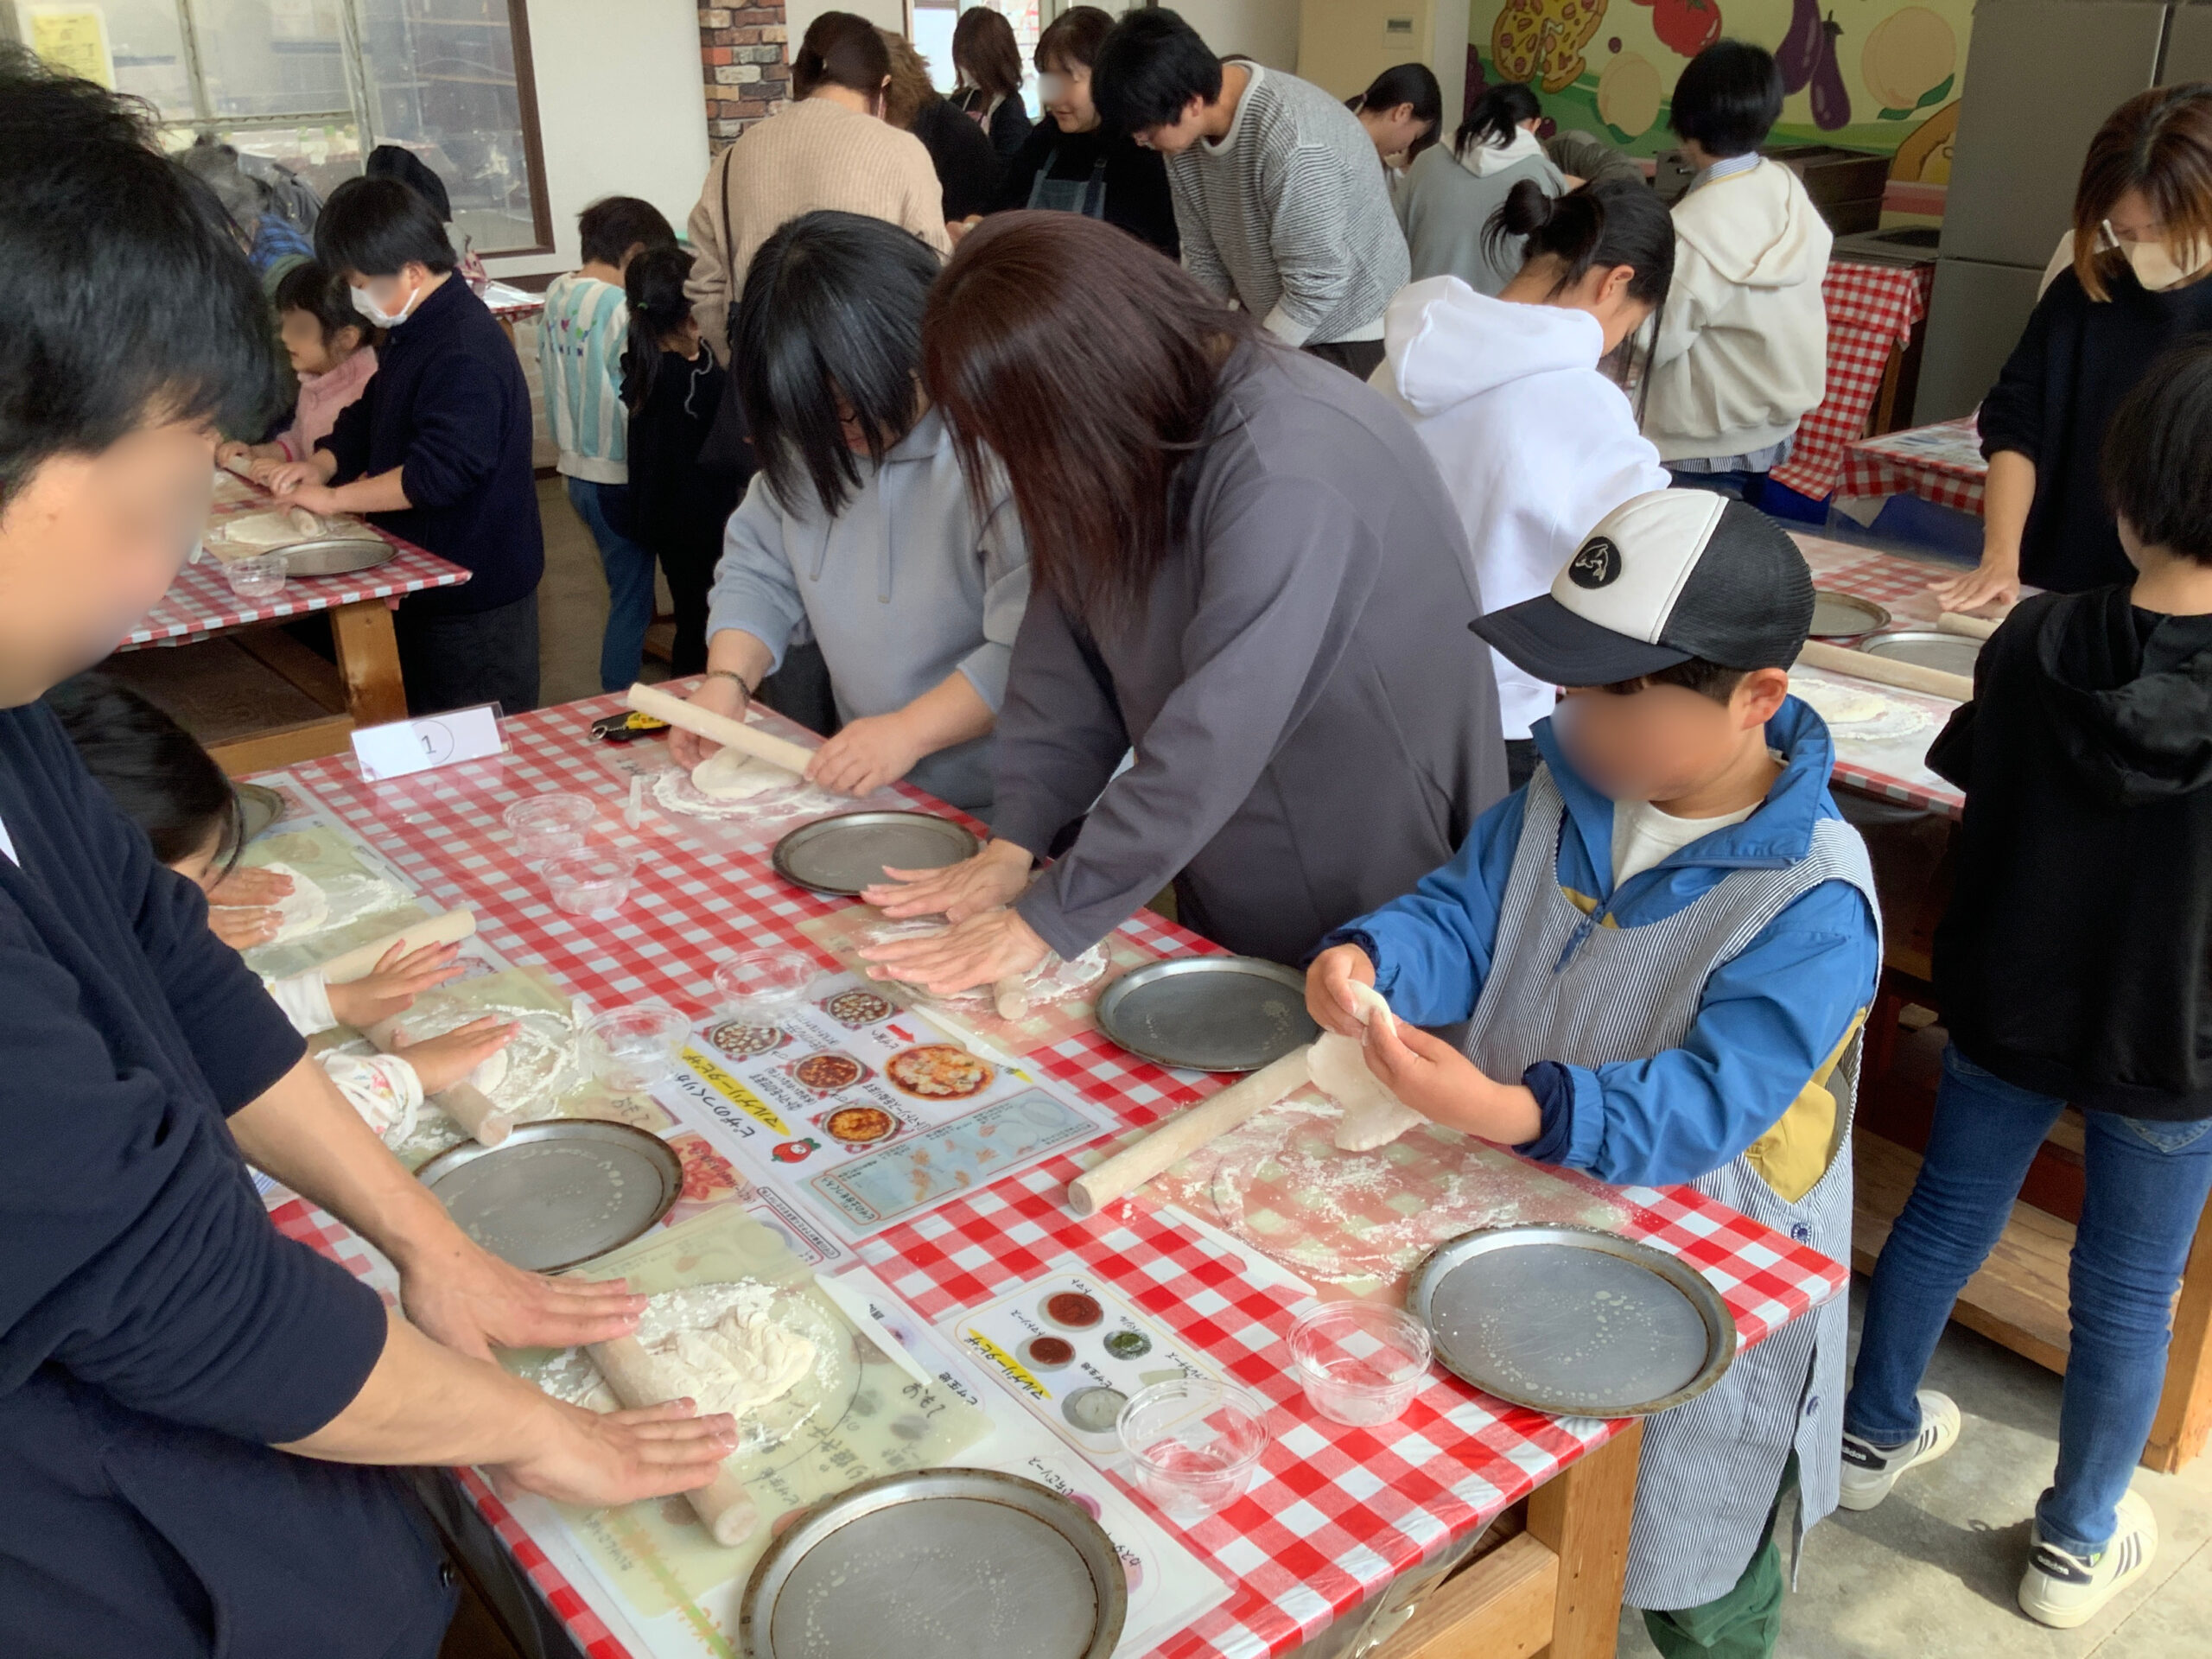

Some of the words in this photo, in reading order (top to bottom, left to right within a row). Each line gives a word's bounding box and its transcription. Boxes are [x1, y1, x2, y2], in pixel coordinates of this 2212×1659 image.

[682, 1052, 781, 1128] マルゲリータピザ
[674, 1072, 755, 1139] ピザのつくりか
[1068, 1278, 1092, 1294] トマト
[1008, 1309, 1046, 1336] トマトソース
[1116, 1315, 1141, 1332] バジル
[964, 1335, 1048, 1400] マルゲリータピザ
[1079, 1362, 1115, 1388] ピザ生地
[902, 1382, 946, 1418] おもて
[1842, 1446, 1866, 1461] didas
[1027, 1458, 1076, 1497] いちごソース
[2037, 1555, 2069, 1575] adidas
